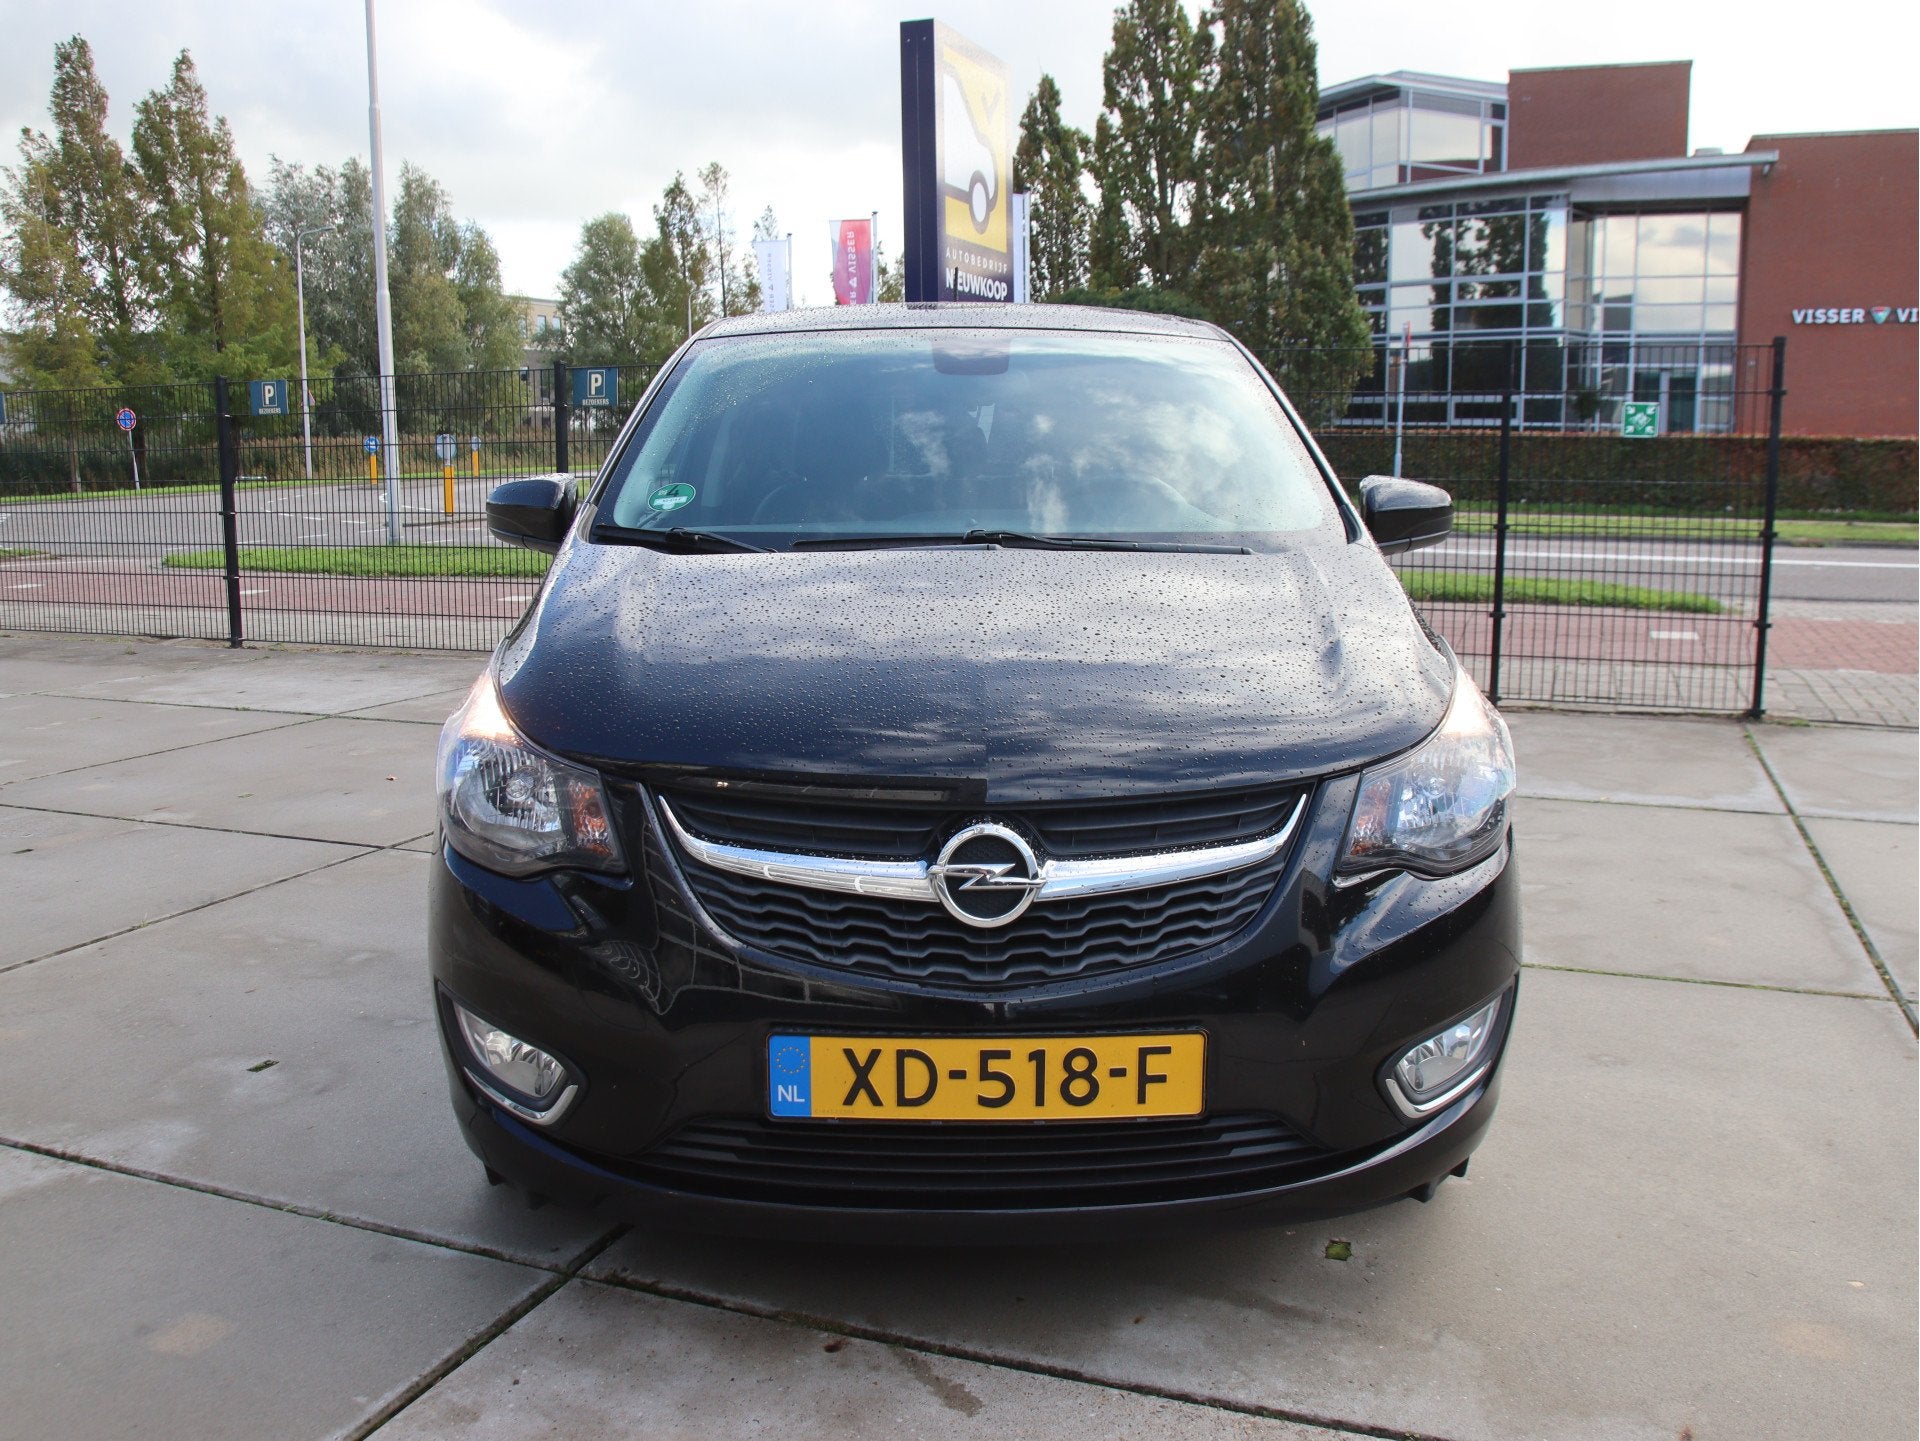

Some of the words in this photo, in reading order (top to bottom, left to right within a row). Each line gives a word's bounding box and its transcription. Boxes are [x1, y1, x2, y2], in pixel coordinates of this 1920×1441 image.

[946, 246, 1008, 275] AUTOBEDRIJF
[946, 267, 1008, 300] NEUWKOOP
[1792, 308, 1866, 324] VISSER
[591, 373, 602, 395] P
[264, 385, 274, 404] P
[667, 485, 679, 496] 4
[842, 1046, 1172, 1108] XD-518-F
[778, 1085, 805, 1103] NL
